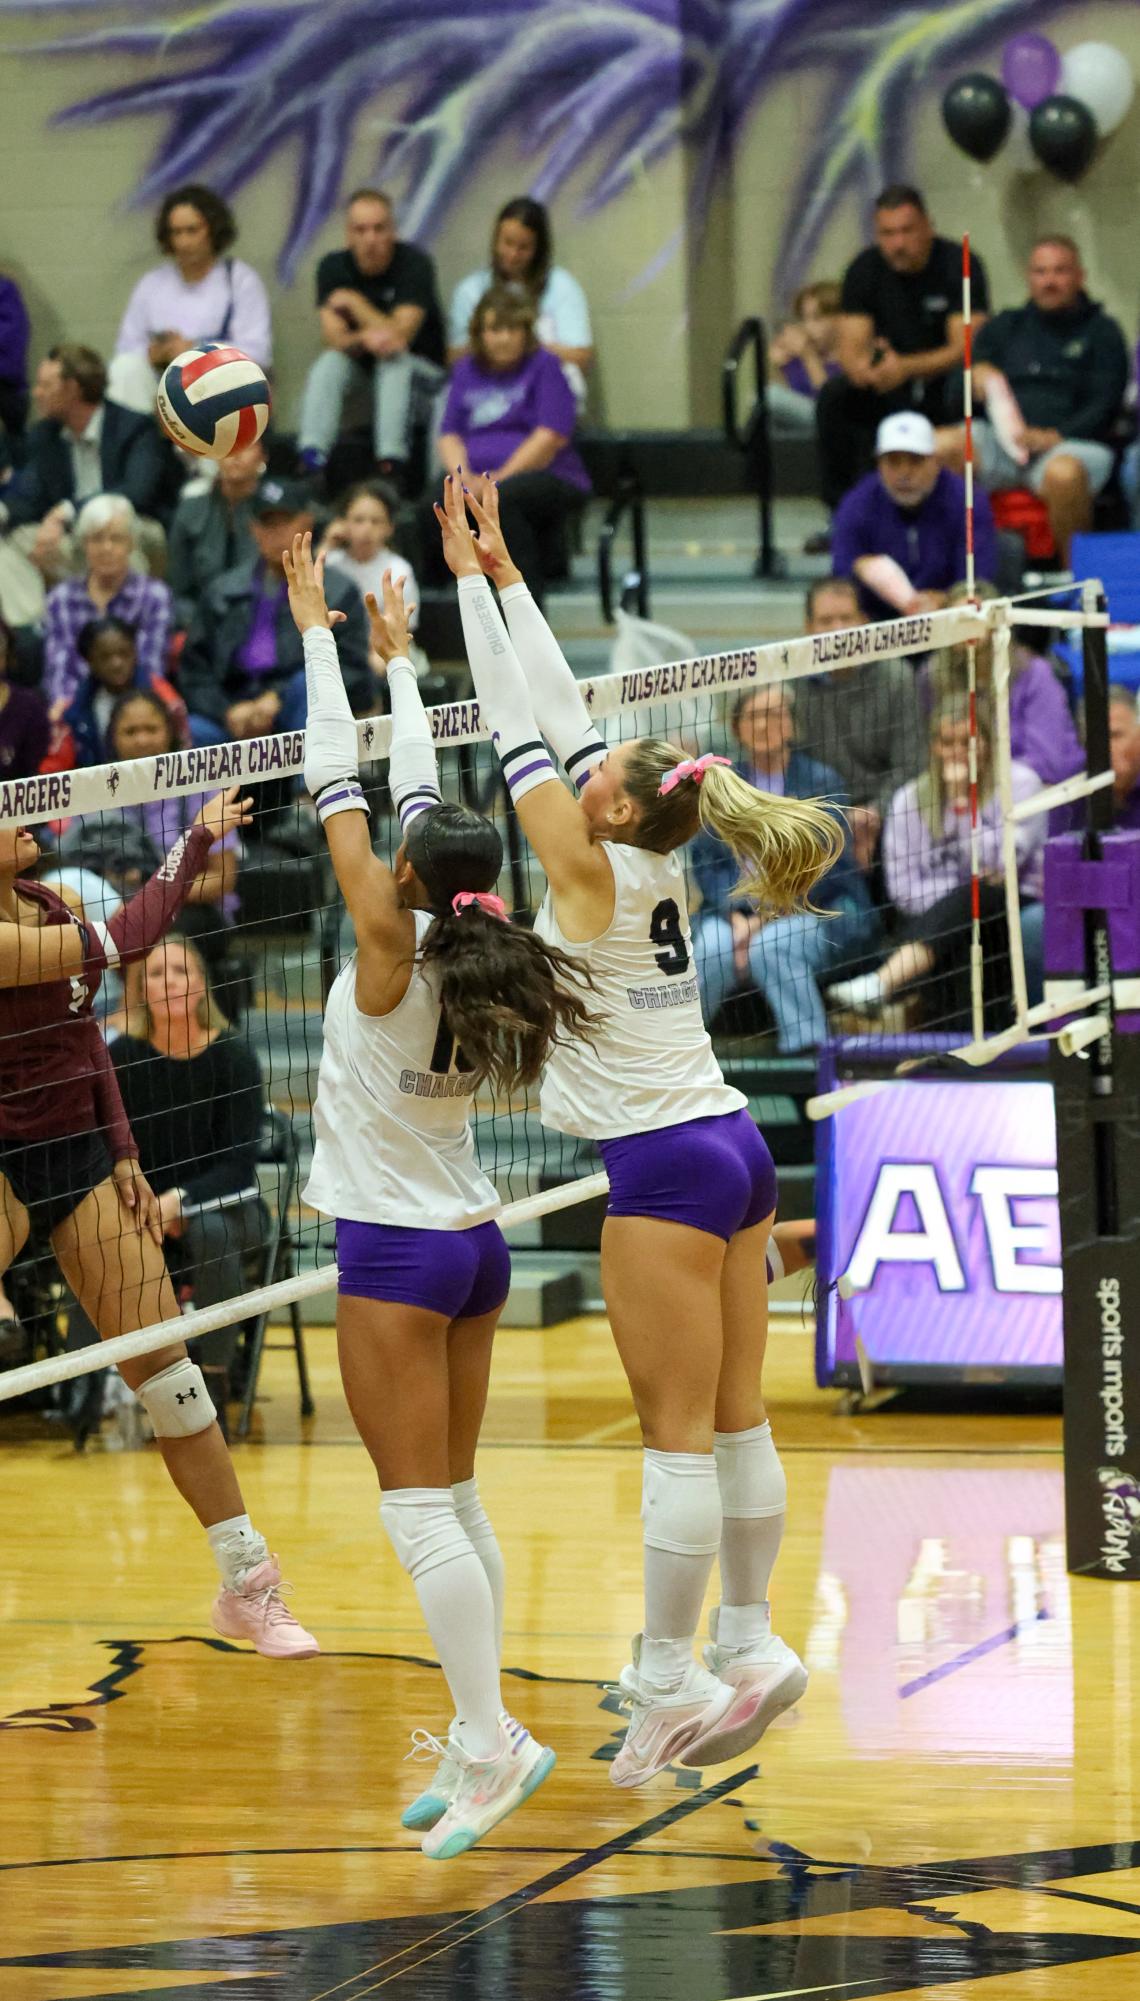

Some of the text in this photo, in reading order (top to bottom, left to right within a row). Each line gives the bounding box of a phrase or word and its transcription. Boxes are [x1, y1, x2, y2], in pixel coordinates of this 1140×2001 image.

[472, 595, 506, 656] CHARGERS
[812, 628, 872, 665] FULSHEAR
[620, 650, 757, 704] FULSHEAR CHARGERS
[429, 702, 480, 738] SHEAR
[154, 743, 242, 790] FULSHEAR
[0, 774, 71, 819] ARGERS
[649, 897, 689, 976] 9
[627, 979, 699, 1009] CHARGE
[430, 978, 484, 1074] 1
[848, 1162, 1063, 1294] AE
[1096, 1278, 1125, 1358] sports
[1099, 1359, 1129, 1457] imports
